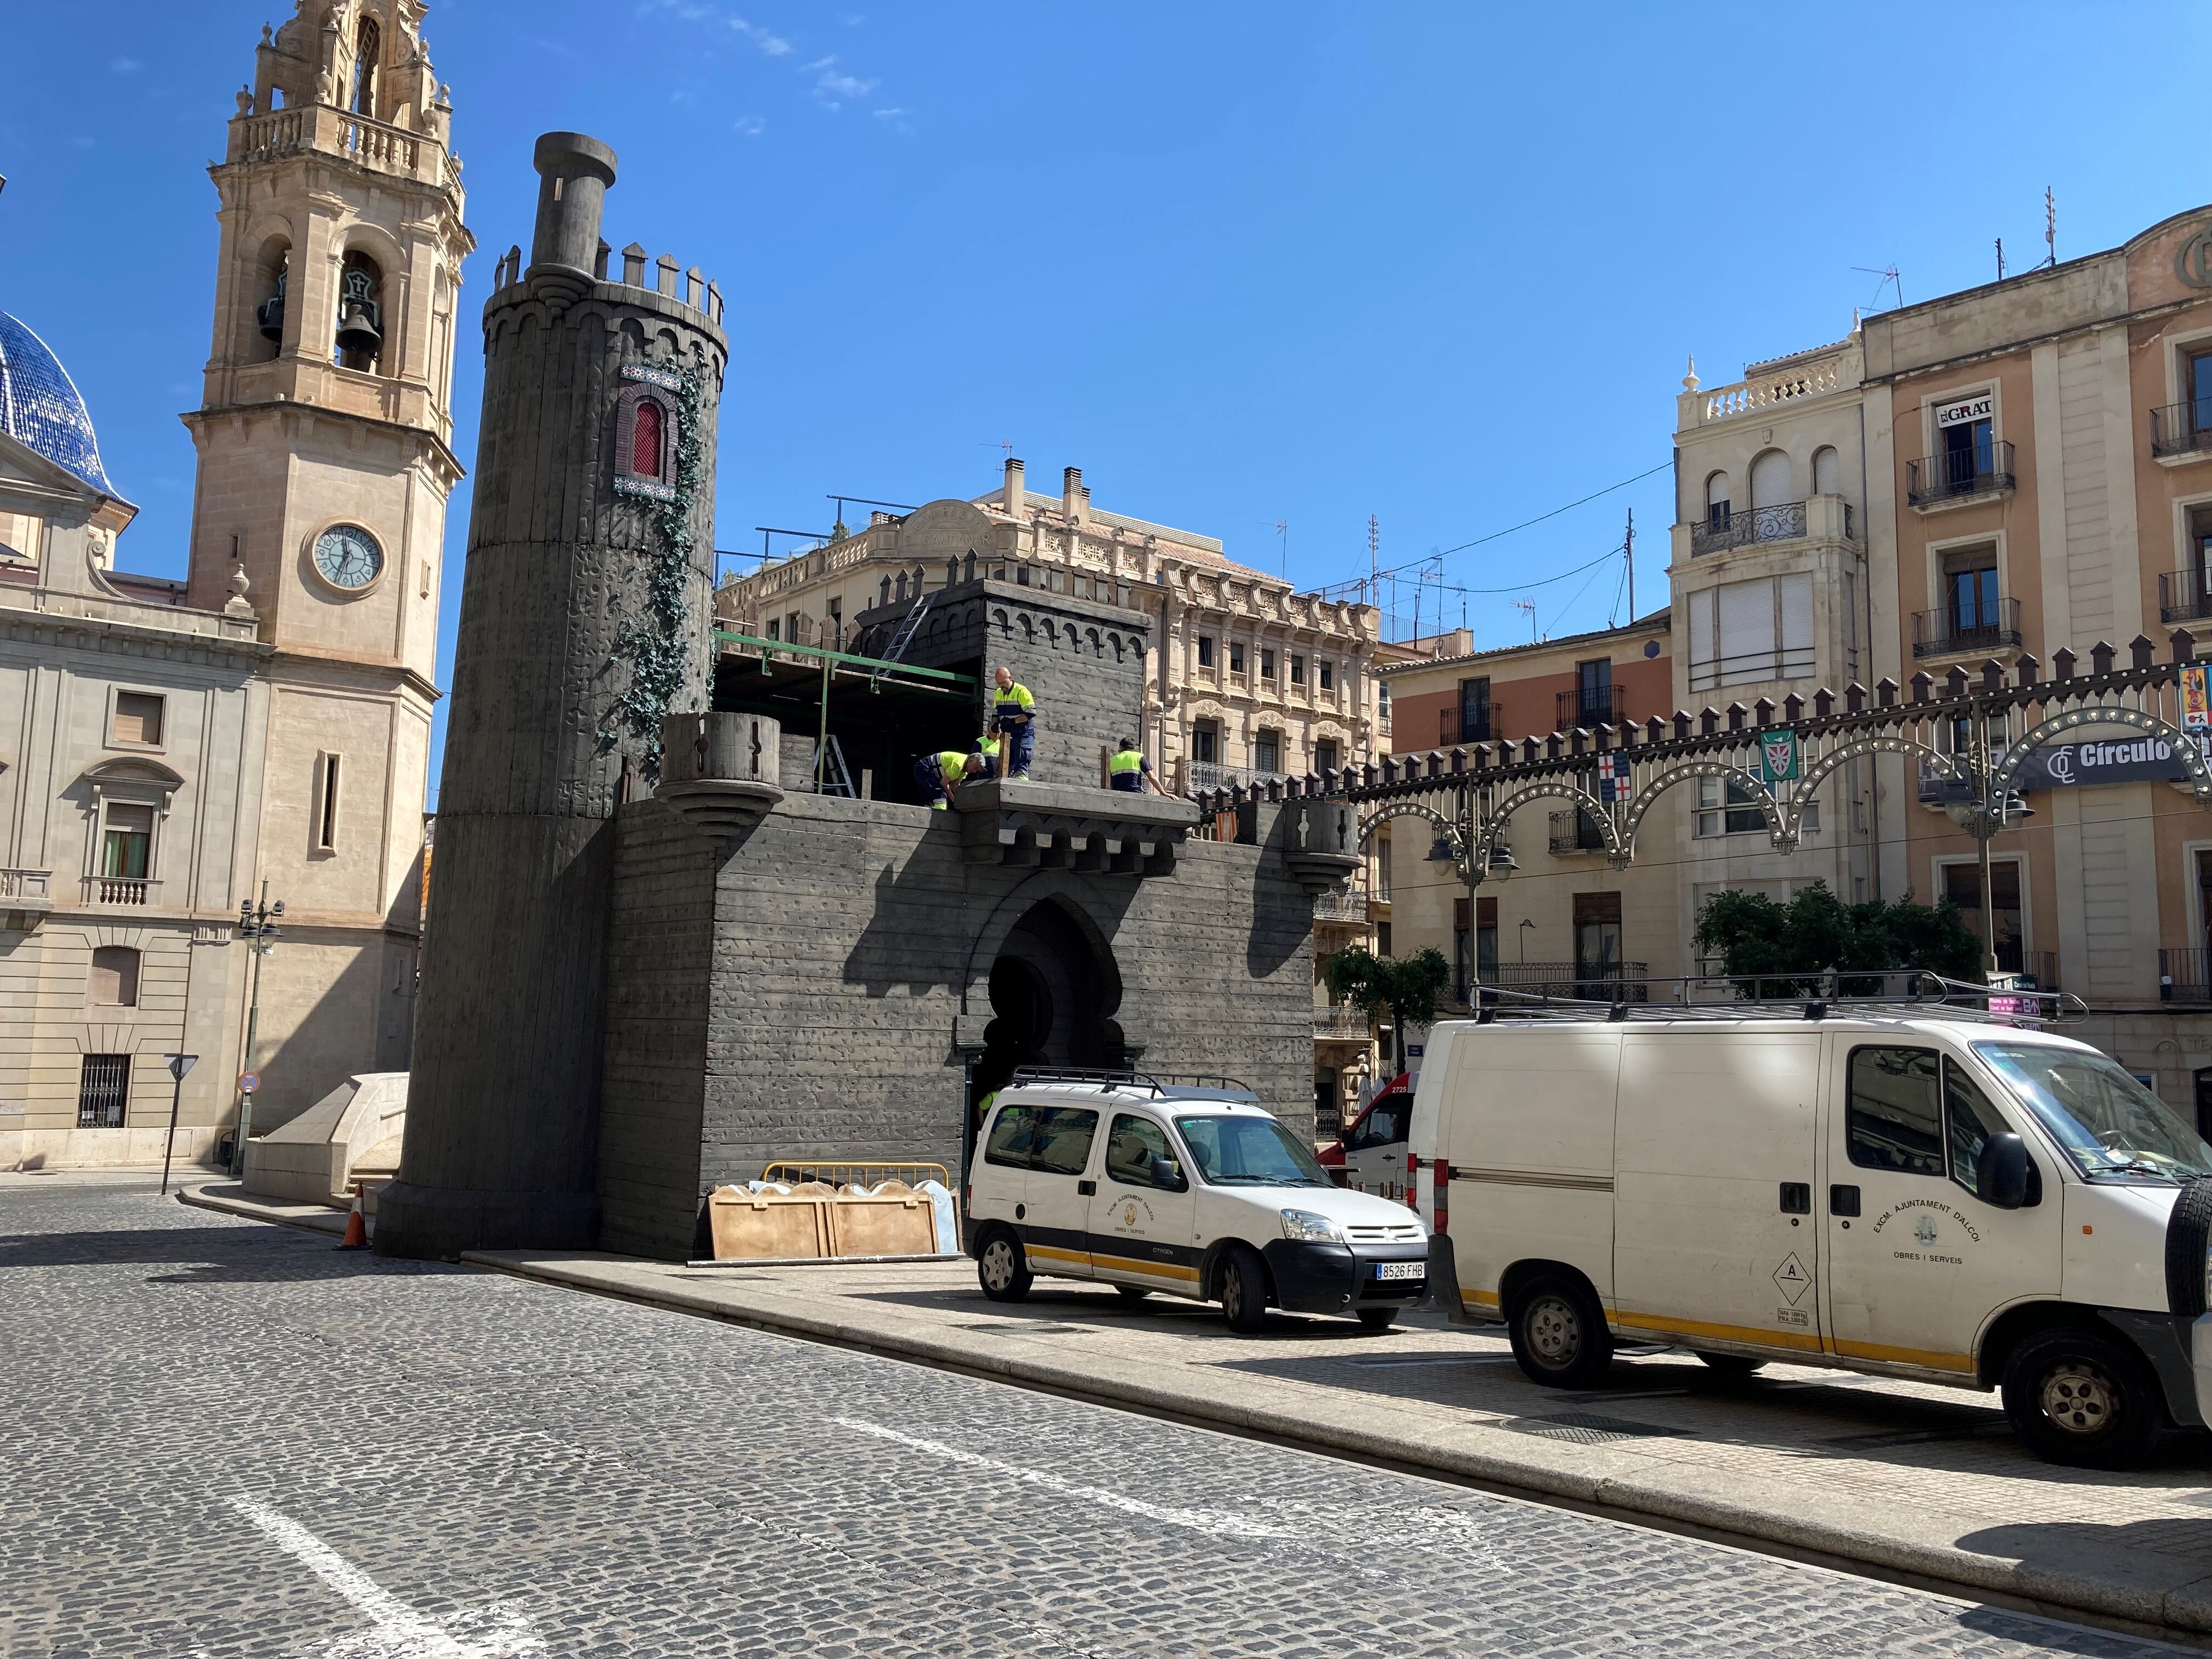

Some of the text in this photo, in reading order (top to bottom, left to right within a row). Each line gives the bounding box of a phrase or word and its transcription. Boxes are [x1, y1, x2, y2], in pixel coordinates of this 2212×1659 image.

[912, 506, 983, 531] EDIFICIO
[922, 533, 991, 545] CAMPANAR
[2080, 738, 2171, 767] Círculo
[2187, 1039, 2212, 1051] TE
[1873, 1199, 1980, 1243] EXCM. AJUNTAMENT D'ALCOI
[1894, 1251, 1920, 1261] OBRES
[1929, 1255, 1963, 1265] SERVEIS
[1383, 1264, 1423, 1278] 8526 FHB
[1788, 1264, 1796, 1277] A
